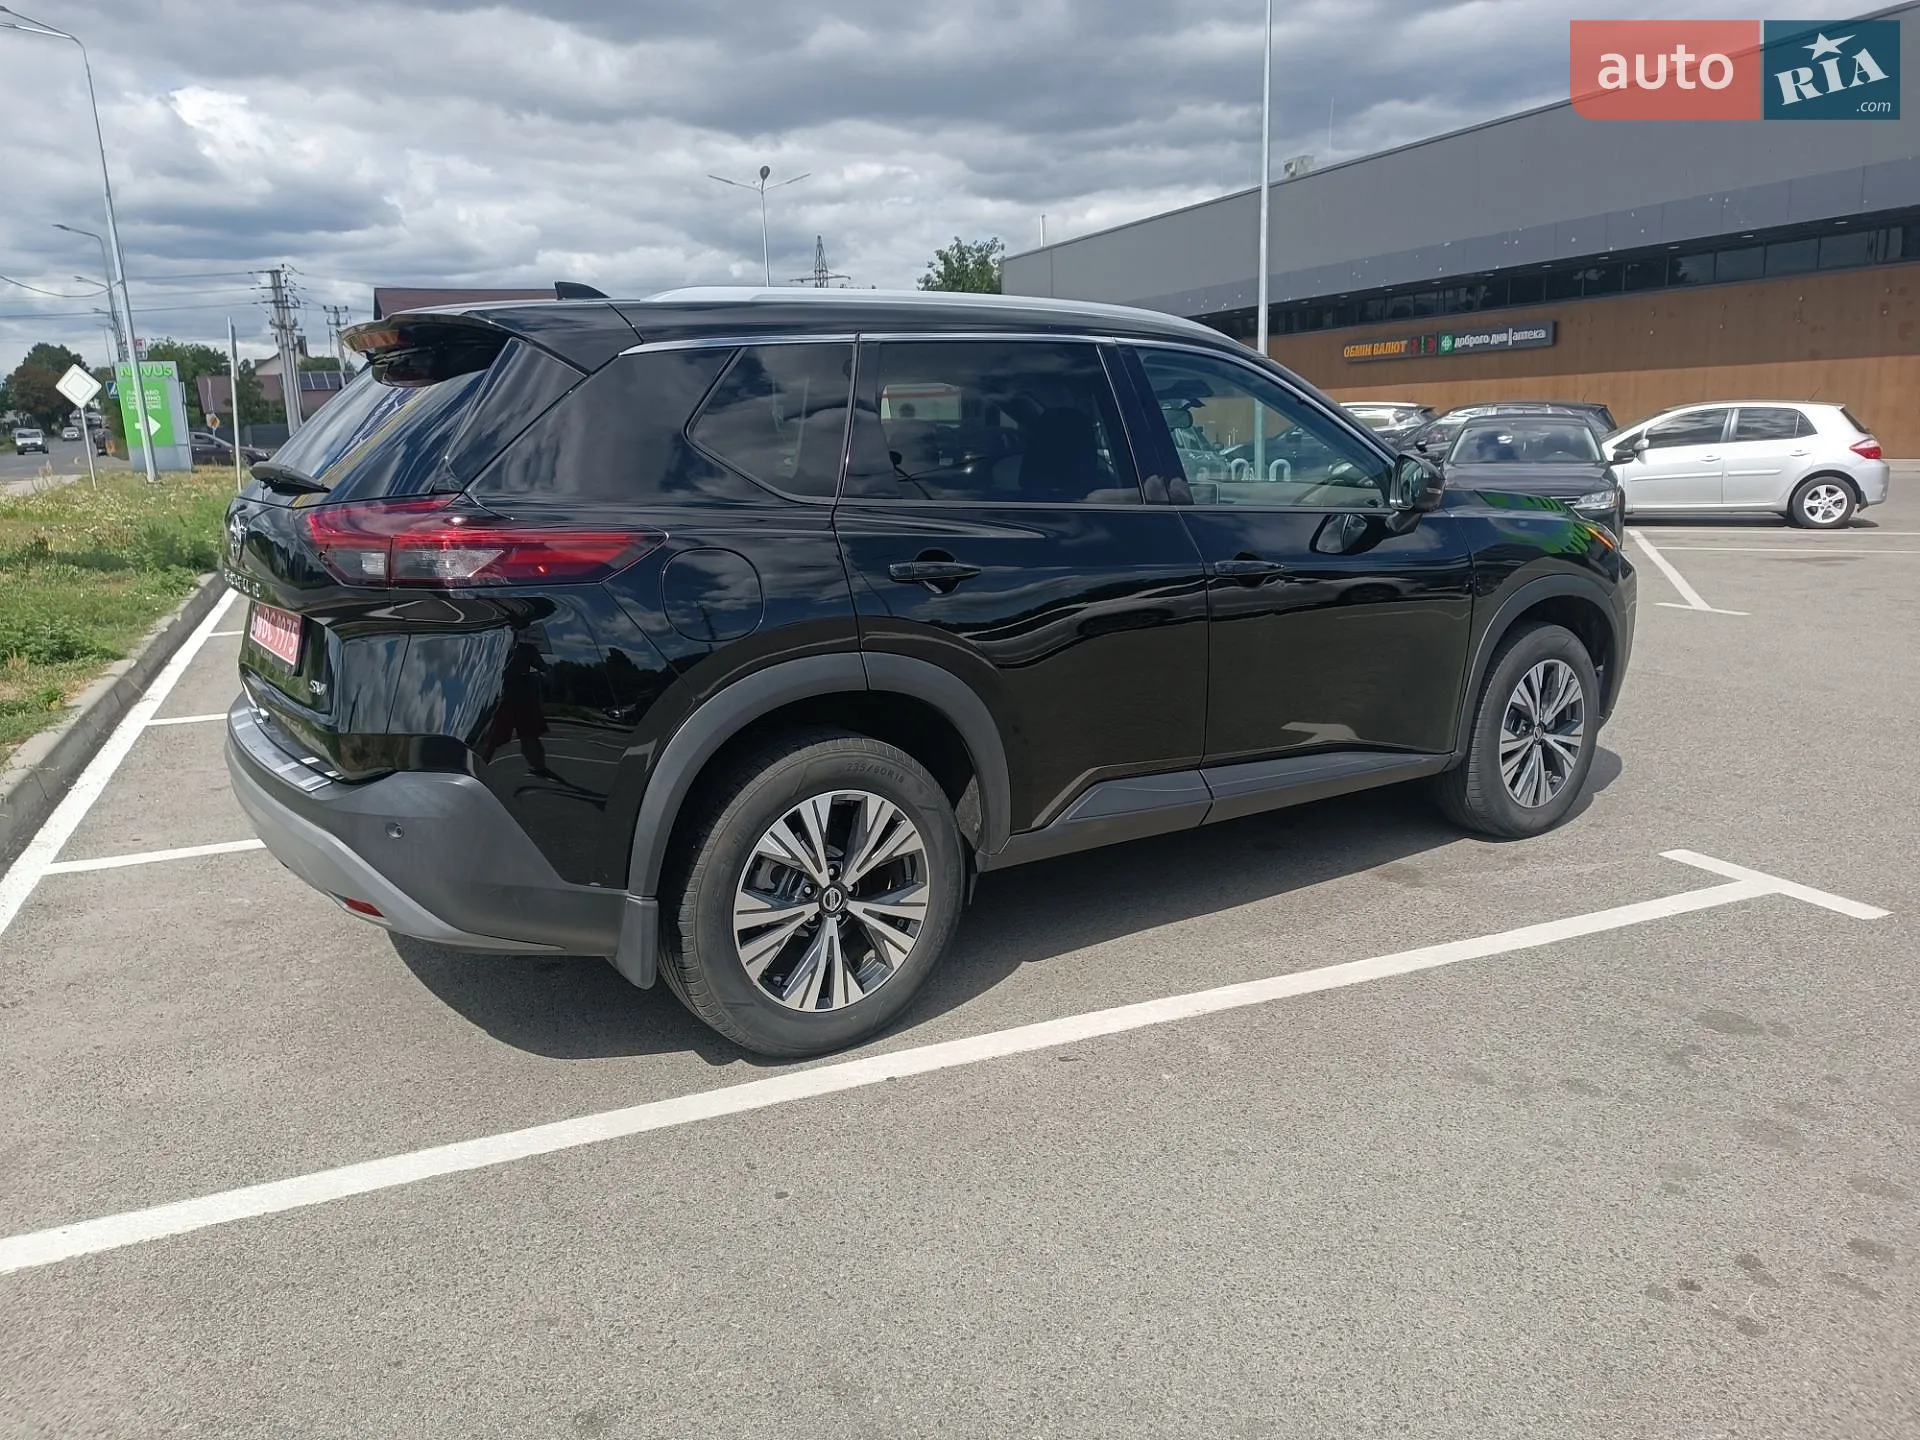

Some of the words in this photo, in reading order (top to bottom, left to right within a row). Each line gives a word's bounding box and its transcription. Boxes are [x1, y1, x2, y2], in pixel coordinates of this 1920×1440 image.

[1454, 334, 1490, 348] доброго
[1490, 331, 1508, 345] дня
[1512, 328, 1547, 341] аптека
[1343, 343, 1373, 358] ОБМІН
[1373, 340, 1408, 355] ВАЛЮТ
[120, 365, 173, 378] NVUS
